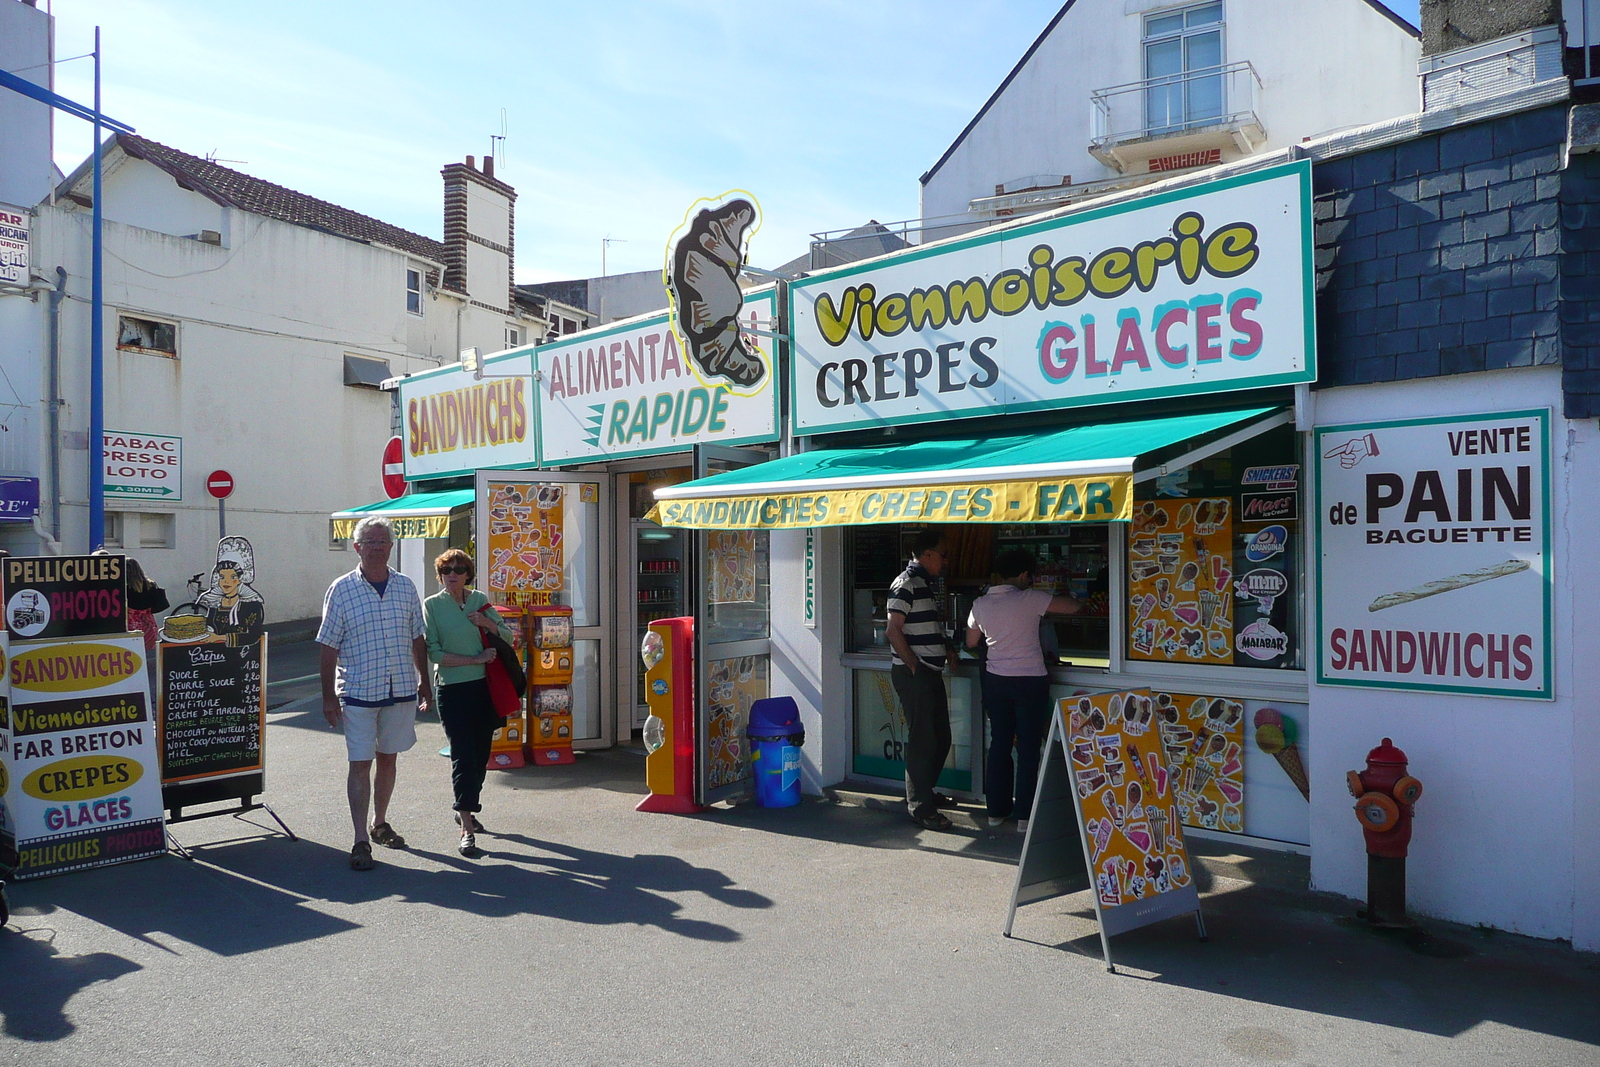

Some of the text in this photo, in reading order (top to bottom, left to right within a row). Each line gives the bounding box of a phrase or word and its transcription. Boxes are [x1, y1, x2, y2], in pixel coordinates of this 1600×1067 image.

[813, 210, 1261, 347] Viennoiserie
[1038, 287, 1264, 385] GLACES
[814, 337, 999, 409] CREPES
[408, 377, 527, 458] SANDWICHS
[607, 386, 730, 448] RAPIDE
[103, 436, 175, 452] TABAC
[1447, 425, 1531, 457] VENTE
[107, 465, 168, 479] LOTO
[1246, 467, 1294, 482] SNICKERS
[662, 482, 1114, 525] SANDWICHES CREPES FAR
[1244, 497, 1292, 517] Mars
[1329, 465, 1532, 526] de PAIN
[1250, 543, 1283, 552] ORANGINA
[1366, 526, 1532, 544] BAGUETTE
[10, 558, 121, 584] PELLICULES
[51, 588, 121, 620] PHOTOS
[1241, 635, 1284, 651] MALABAR
[1330, 627, 1533, 681] SANDWICHS
[10, 651, 134, 685] SANDWICHS
[169, 670, 199, 681] SUCRE
[170, 680, 205, 691] BEURRE
[13, 700, 138, 732] Viennoiserie
[13, 728, 143, 760] FAR BRETON
[166, 727, 206, 740] CHOCOLAT
[38, 762, 130, 794] CREPES
[45, 796, 132, 831] GLACES
[19, 828, 162, 869] PELLICULES PHOTOS
